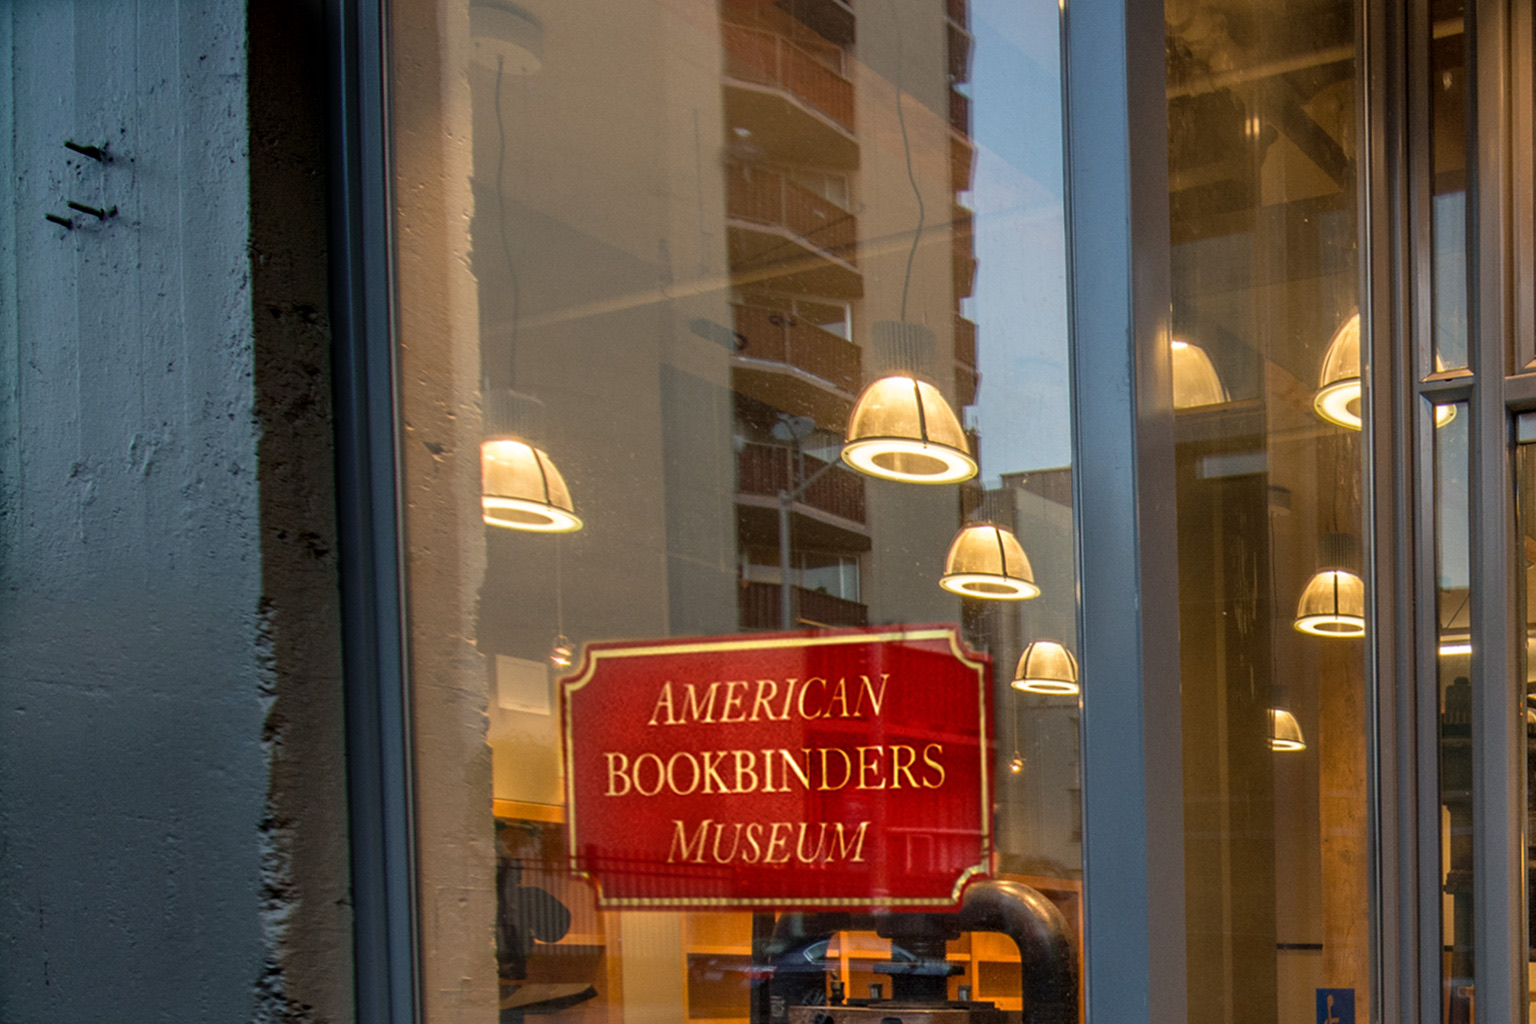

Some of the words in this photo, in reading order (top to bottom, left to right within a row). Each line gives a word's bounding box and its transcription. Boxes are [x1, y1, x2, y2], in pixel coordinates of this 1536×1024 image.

[648, 673, 889, 726] AMERICAN
[604, 743, 946, 796] BOOKBINDERS
[667, 819, 870, 863] MUSEUM
